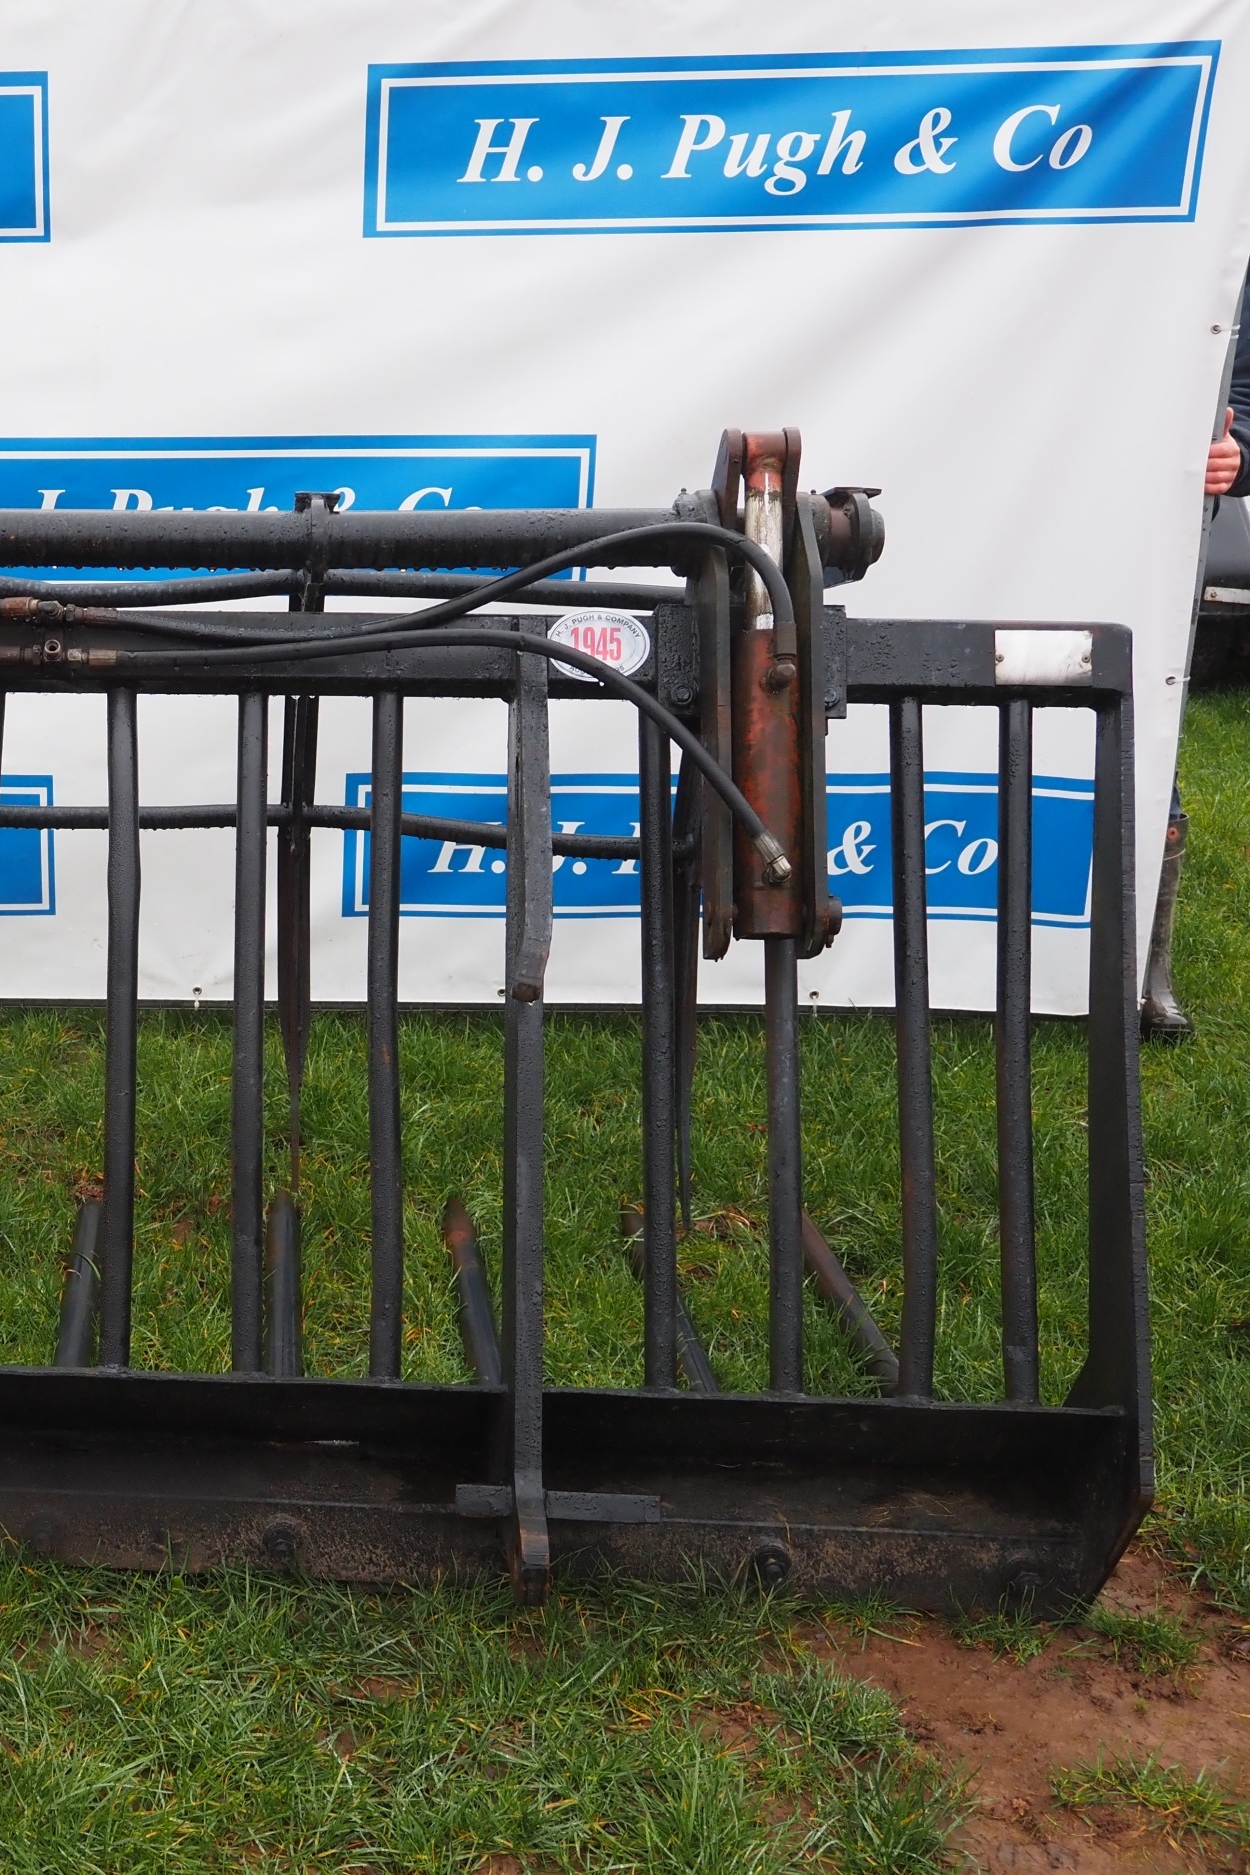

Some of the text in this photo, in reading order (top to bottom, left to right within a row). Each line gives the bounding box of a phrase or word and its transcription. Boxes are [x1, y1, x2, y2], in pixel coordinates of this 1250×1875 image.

[456, 104, 1094, 197] H. J. Pugh & Co
[570, 626, 622, 661] 1945
[571, 614, 595, 625] PUGH
[604, 614, 642, 639] COMPANY
[826, 820, 878, 876] &
[924, 819, 999, 875] Co
